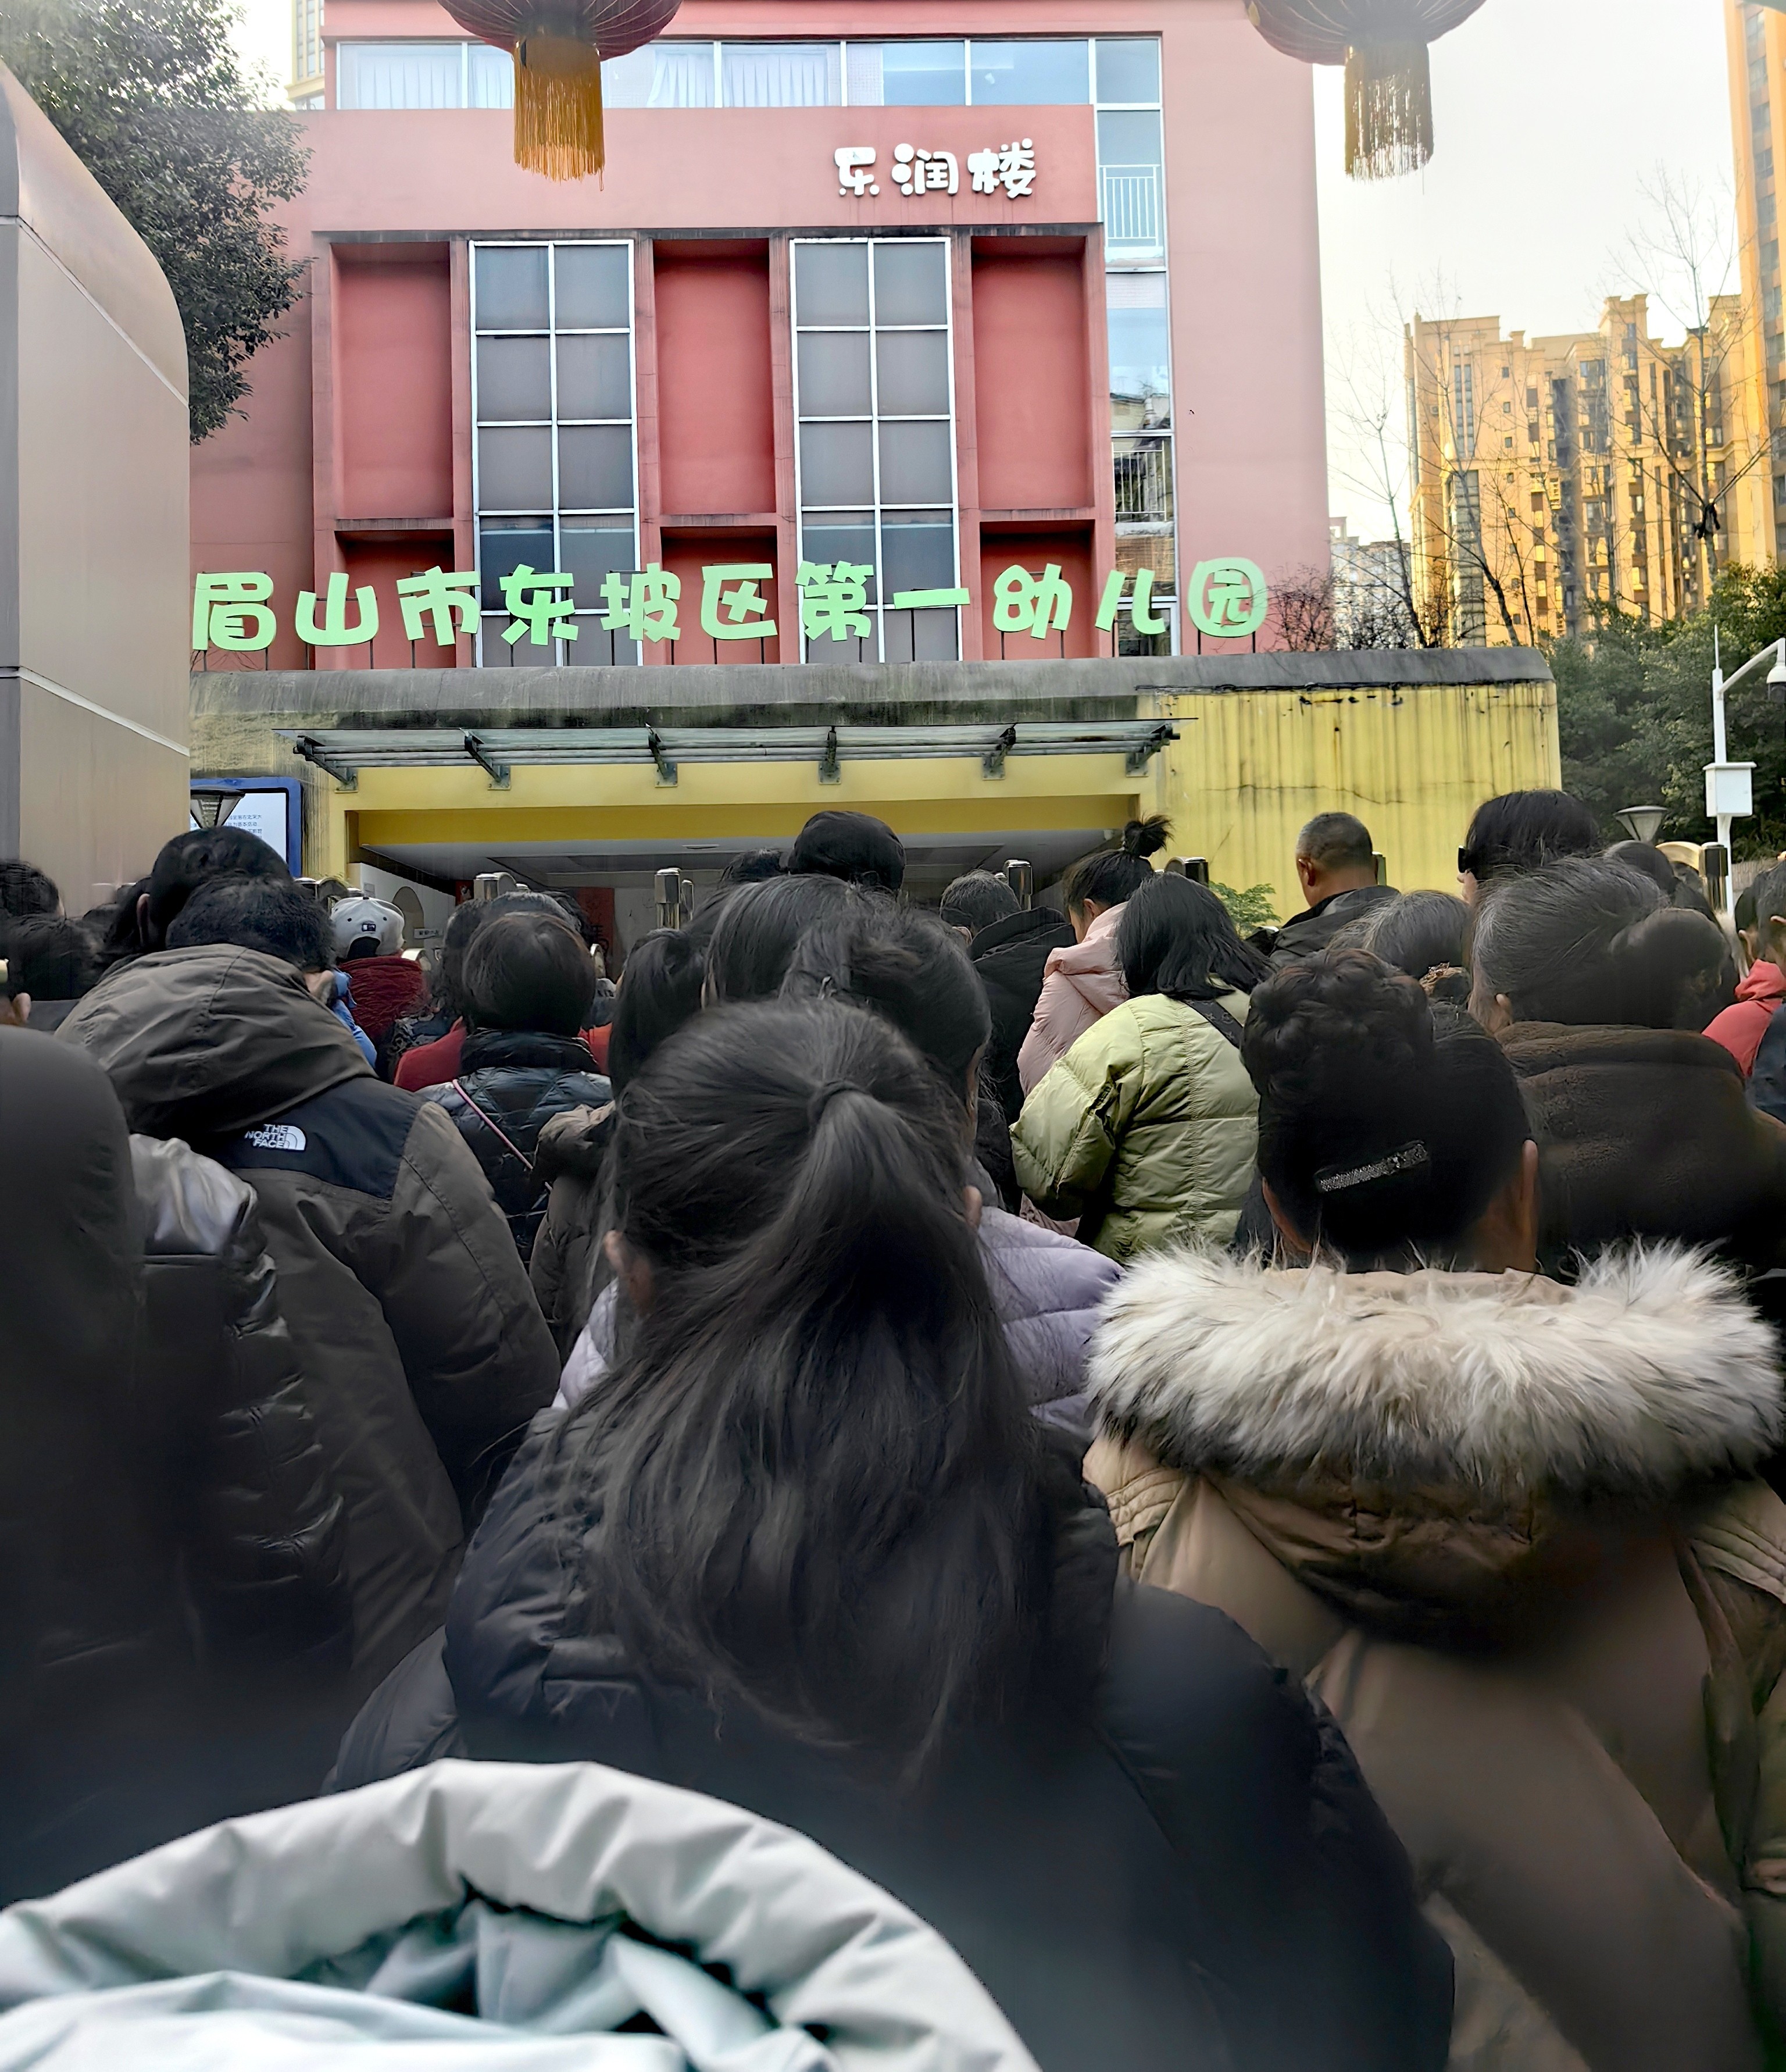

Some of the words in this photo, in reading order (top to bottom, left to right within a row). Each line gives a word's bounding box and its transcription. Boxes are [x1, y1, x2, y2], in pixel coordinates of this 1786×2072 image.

[192, 557, 1269, 652] 眉山市东坡区第一幼儿园
[263, 1124, 288, 1133] THE
[244, 1130, 286, 1141] NORTH
[252, 1139, 285, 1149] FACE
